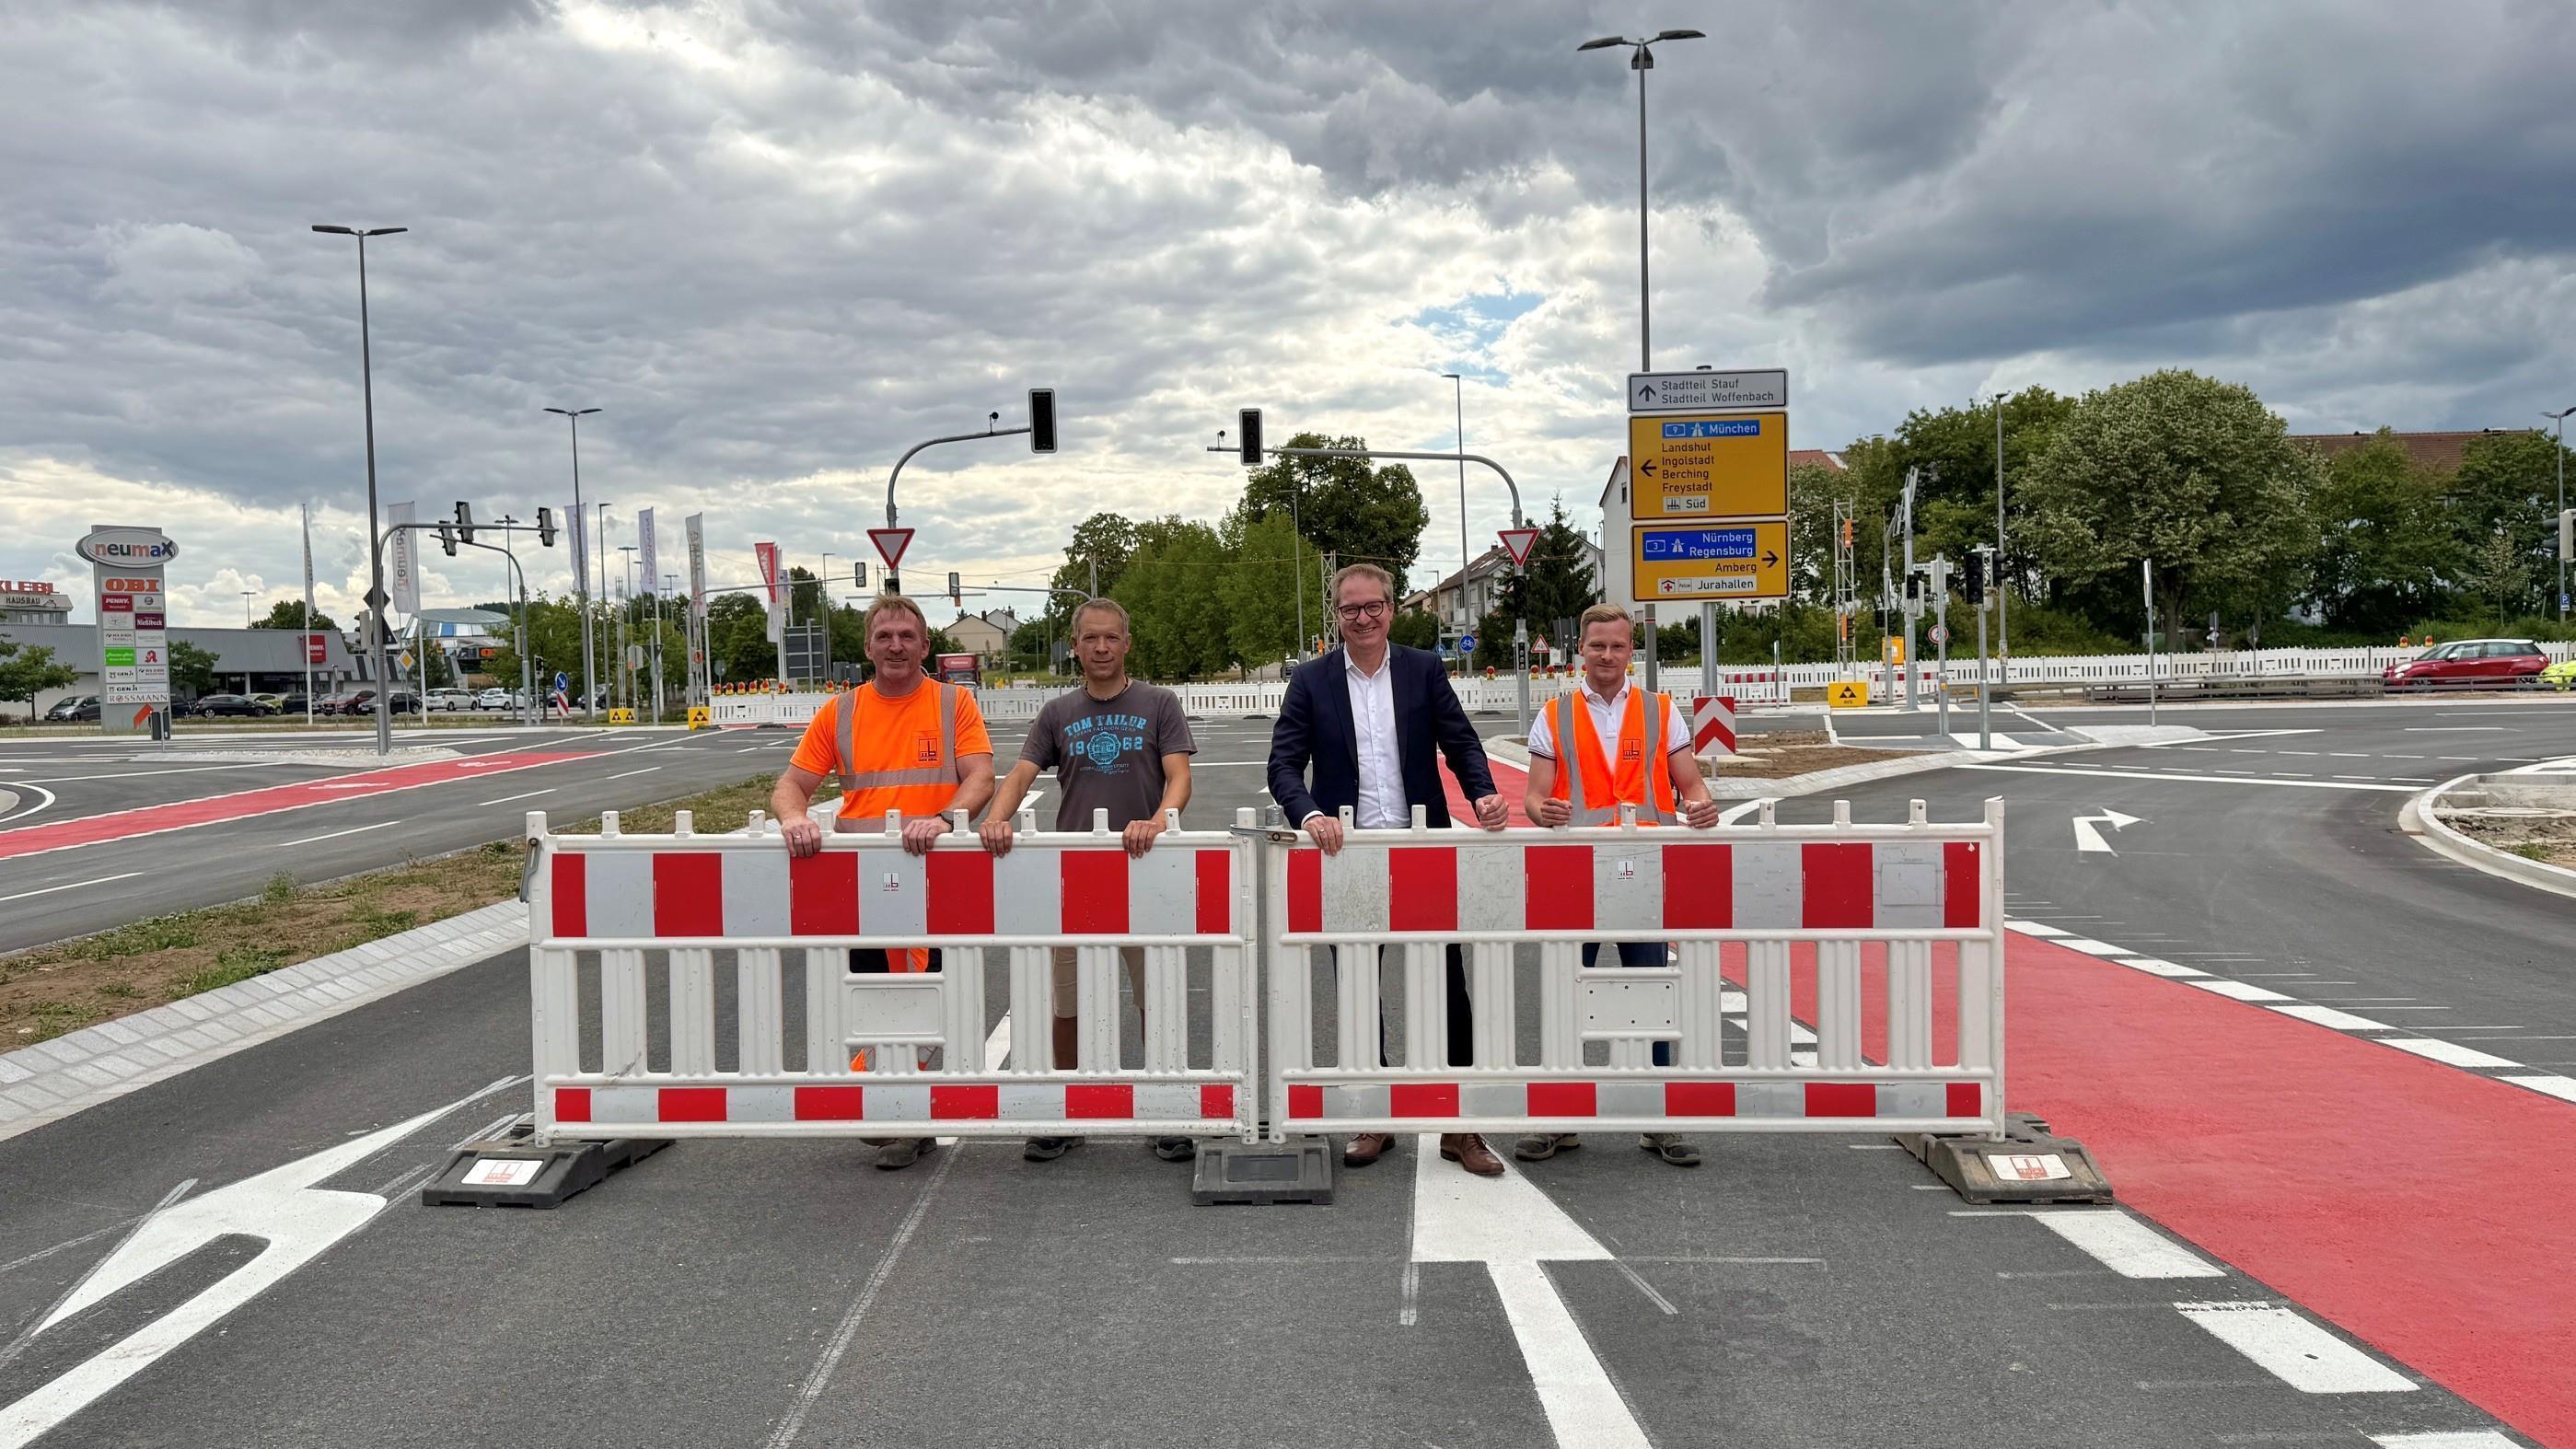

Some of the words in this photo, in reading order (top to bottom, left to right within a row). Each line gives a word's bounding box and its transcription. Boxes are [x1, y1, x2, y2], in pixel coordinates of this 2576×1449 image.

[1661, 378, 1706, 390] Stadtteil
[1712, 377, 1739, 389] Stauf
[1661, 392, 1706, 404] Stadtteil
[1712, 391, 1774, 403] Woffenbach
[1672, 426, 1678, 435] 9
[1709, 423, 1758, 435] München
[1662, 442, 1711, 453] Landshut
[1662, 455, 1714, 468] Ingolstadt
[1662, 469, 1710, 481] Berching
[1662, 482, 1713, 494] Freystadt
[1686, 498, 1706, 509] Süd
[1702, 532, 1753, 544] Nürnberg
[1689, 545, 1753, 558] Regensburg
[1715, 562, 1757, 574] Amberg
[105, 578, 159, 592] OBI
[1698, 578, 1754, 590] Jurahallen
[6, 597, 41, 605] HAUSBAU
[110, 694, 168, 702] ROSSMANN
[1064, 717, 1093, 736] TOM
[1096, 714, 1147, 730] TAILOR
[1068, 740, 1085, 757] 19
[1123, 736, 1143, 751] 62
